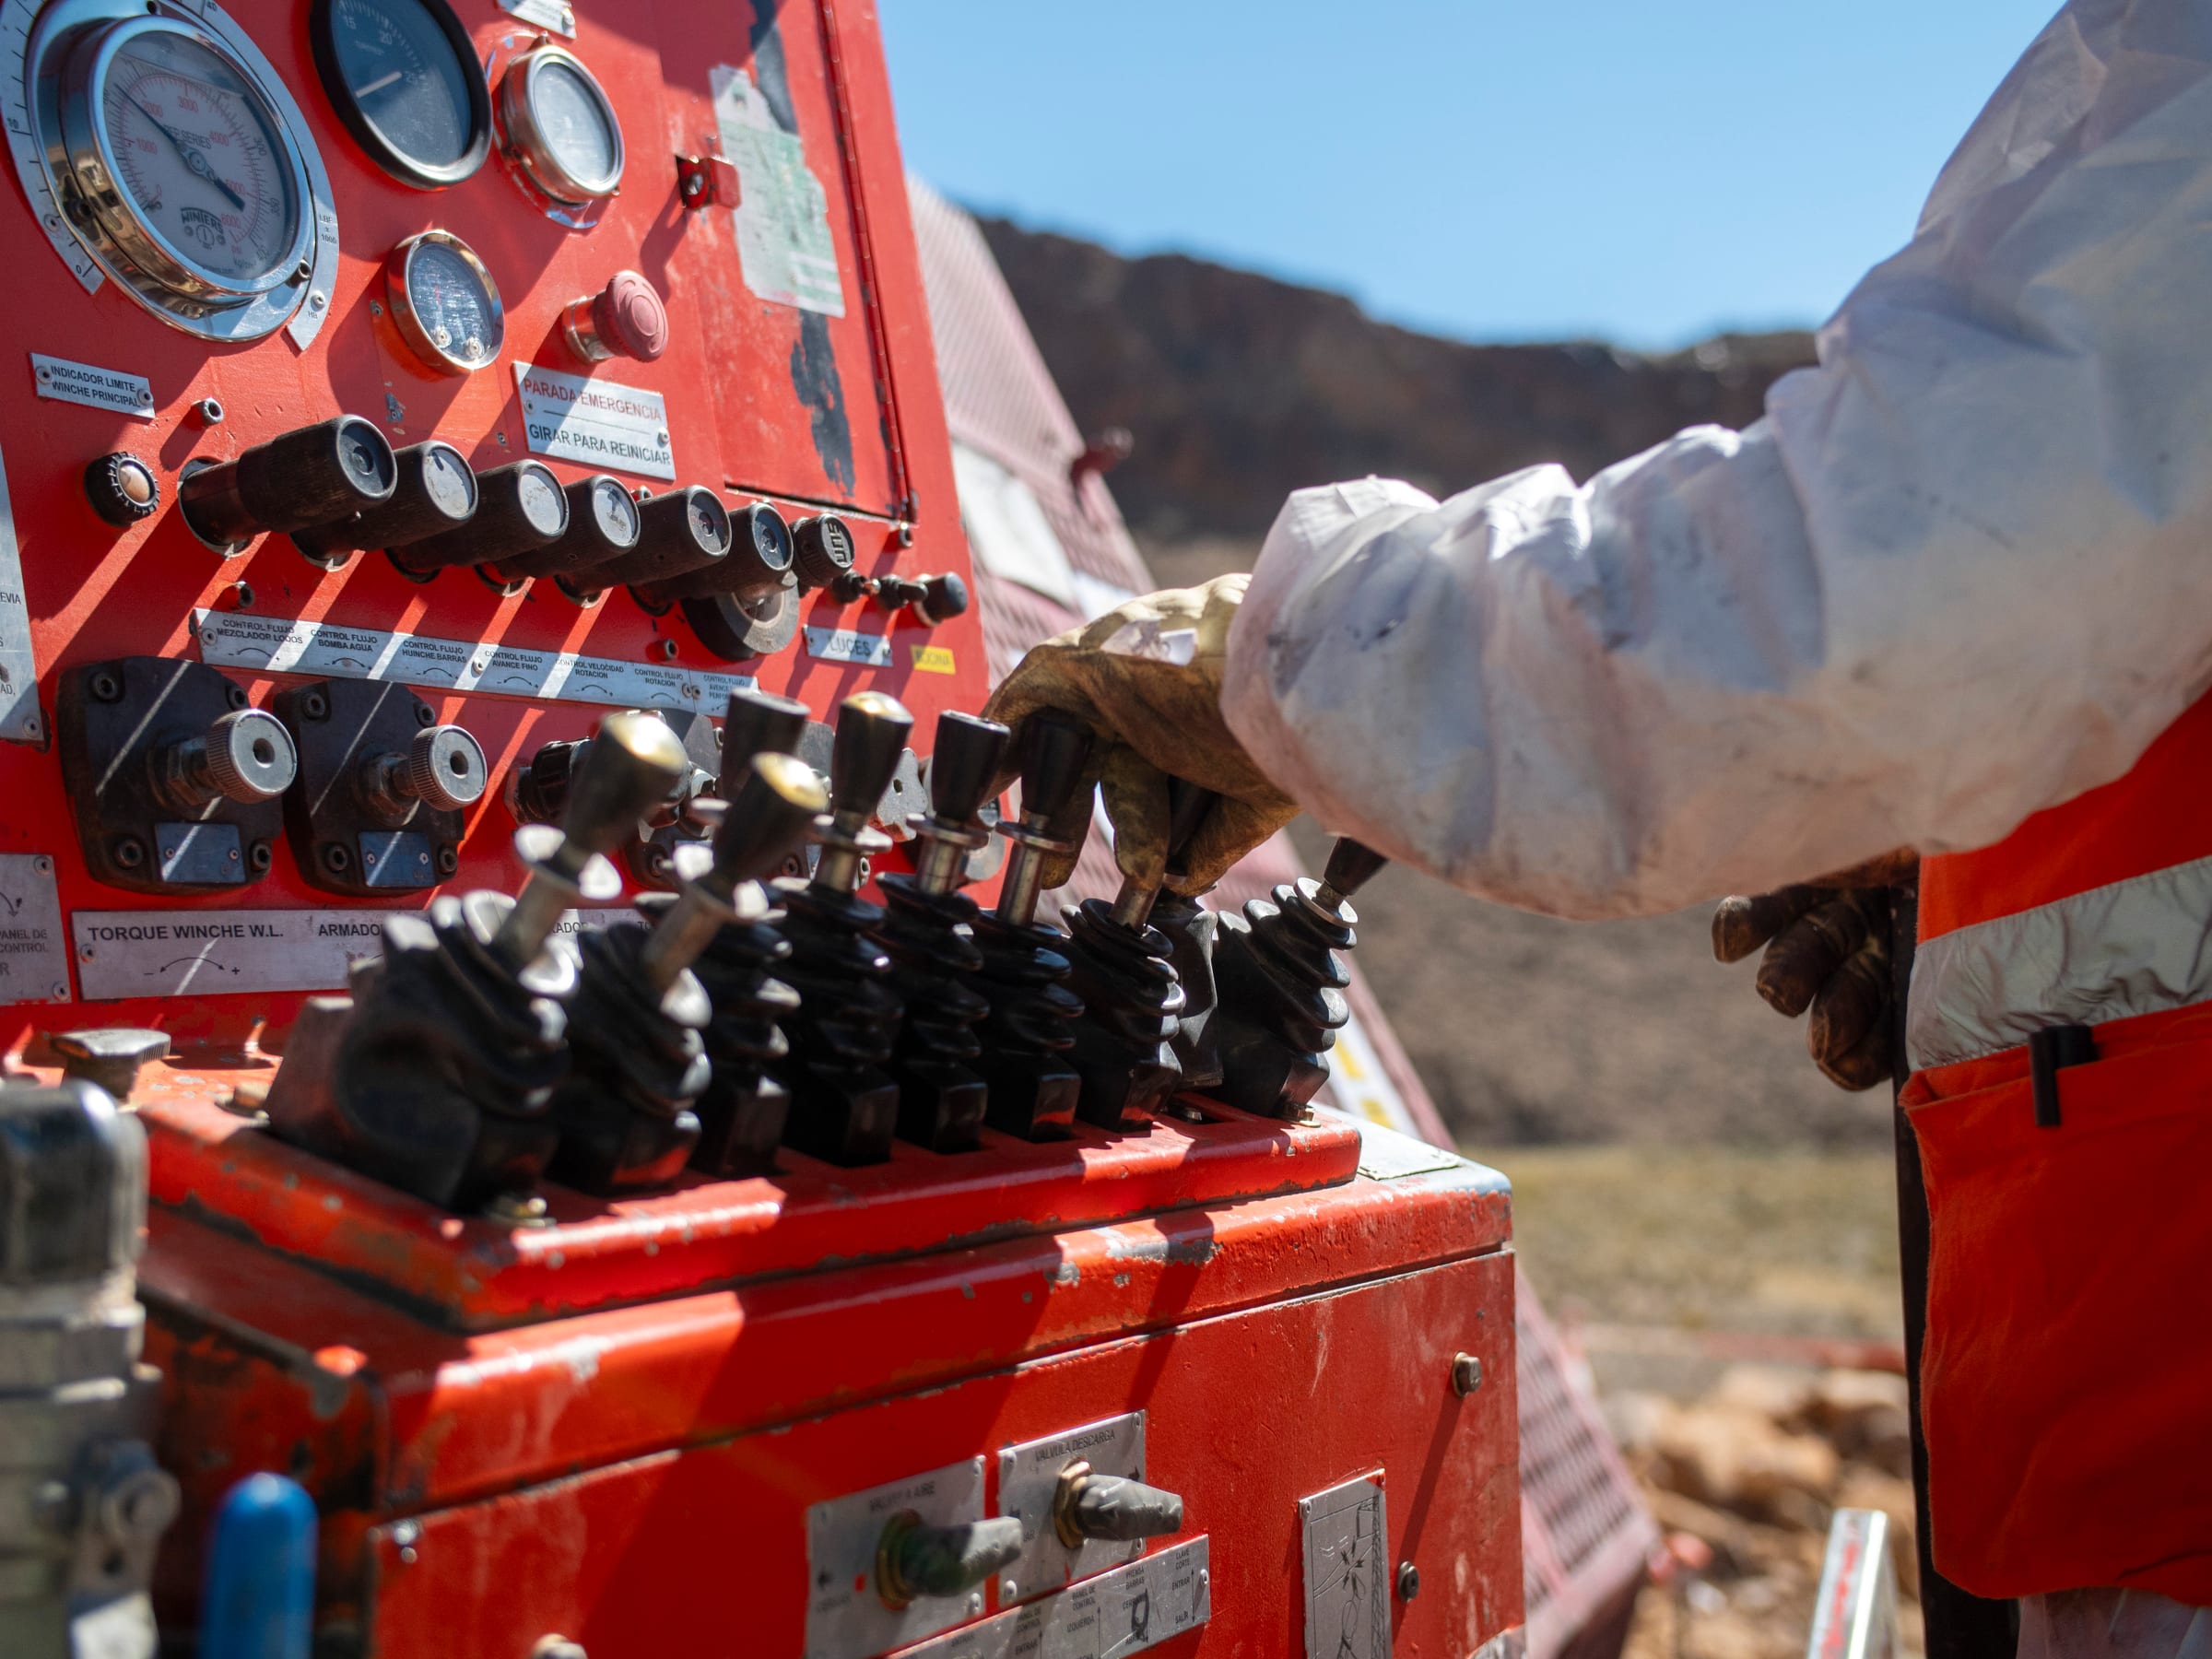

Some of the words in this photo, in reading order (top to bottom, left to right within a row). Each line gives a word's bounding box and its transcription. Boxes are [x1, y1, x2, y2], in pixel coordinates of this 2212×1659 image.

[181, 209, 224, 235] WINTERS
[51, 365, 104, 385] INDICADOR
[106, 378, 135, 393] LIMITE
[52, 381, 90, 397] WINCHE
[92, 389, 141, 407] PRINCIPAL
[524, 378, 577, 403] PARADA
[580, 392, 663, 421] EMERGENCIA
[529, 424, 571, 445] GIRAR
[573, 434, 608, 454] PARA
[611, 441, 671, 465] REINICIAR
[222, 618, 265, 631] CONTROL
[267, 624, 295, 634] FLUJO
[217, 628, 272, 641] MEZCLADOR
[311, 629, 350, 641] CONTROL
[351, 633, 378, 644] FLUJO
[318, 639, 348, 650] BOMBA
[348, 642, 373, 653] AGUA
[403, 640, 440, 651] CONTROL
[440, 644, 464, 654] FLUJO
[830, 635, 872, 657] LUCES
[402, 649, 436, 660] HUINCHE
[437, 653, 467, 664] BARRAS
[485, 650, 519, 661] CONTROL
[520, 653, 543, 664] FLUJO
[492, 659, 520, 669] AVANCE
[522, 663, 538, 671] FINO
[588, 663, 625, 673] VELOCIDAD
[575, 669, 608, 679] ROTACION
[634, 668, 664, 678] CONTROL
[644, 677, 677, 688] ROTACION
[32, 929, 48, 940] DE
[88, 925, 169, 941] TORQUE
[172, 924, 245, 939] WINCHE
[249, 924, 285, 937] W.L.
[318, 924, 383, 936] ARMADO
[1035, 1441, 1071, 1462] VALVULA
[1072, 1430, 1115, 1452] DESCARGA
[1175, 1548, 1190, 1560] CLAVE
[1175, 1558, 1190, 1570] CORTE
[1125, 1577, 1145, 1590] BARRAS
[1171, 1577, 1190, 1591] ENTRAR
[1072, 1598, 1096, 1611] CONTROL
[1066, 1615, 1095, 1633] IZQUIERDA
[1175, 1613, 1189, 1624] SALIR
[1015, 1639, 1039, 1655] ENTRAR
